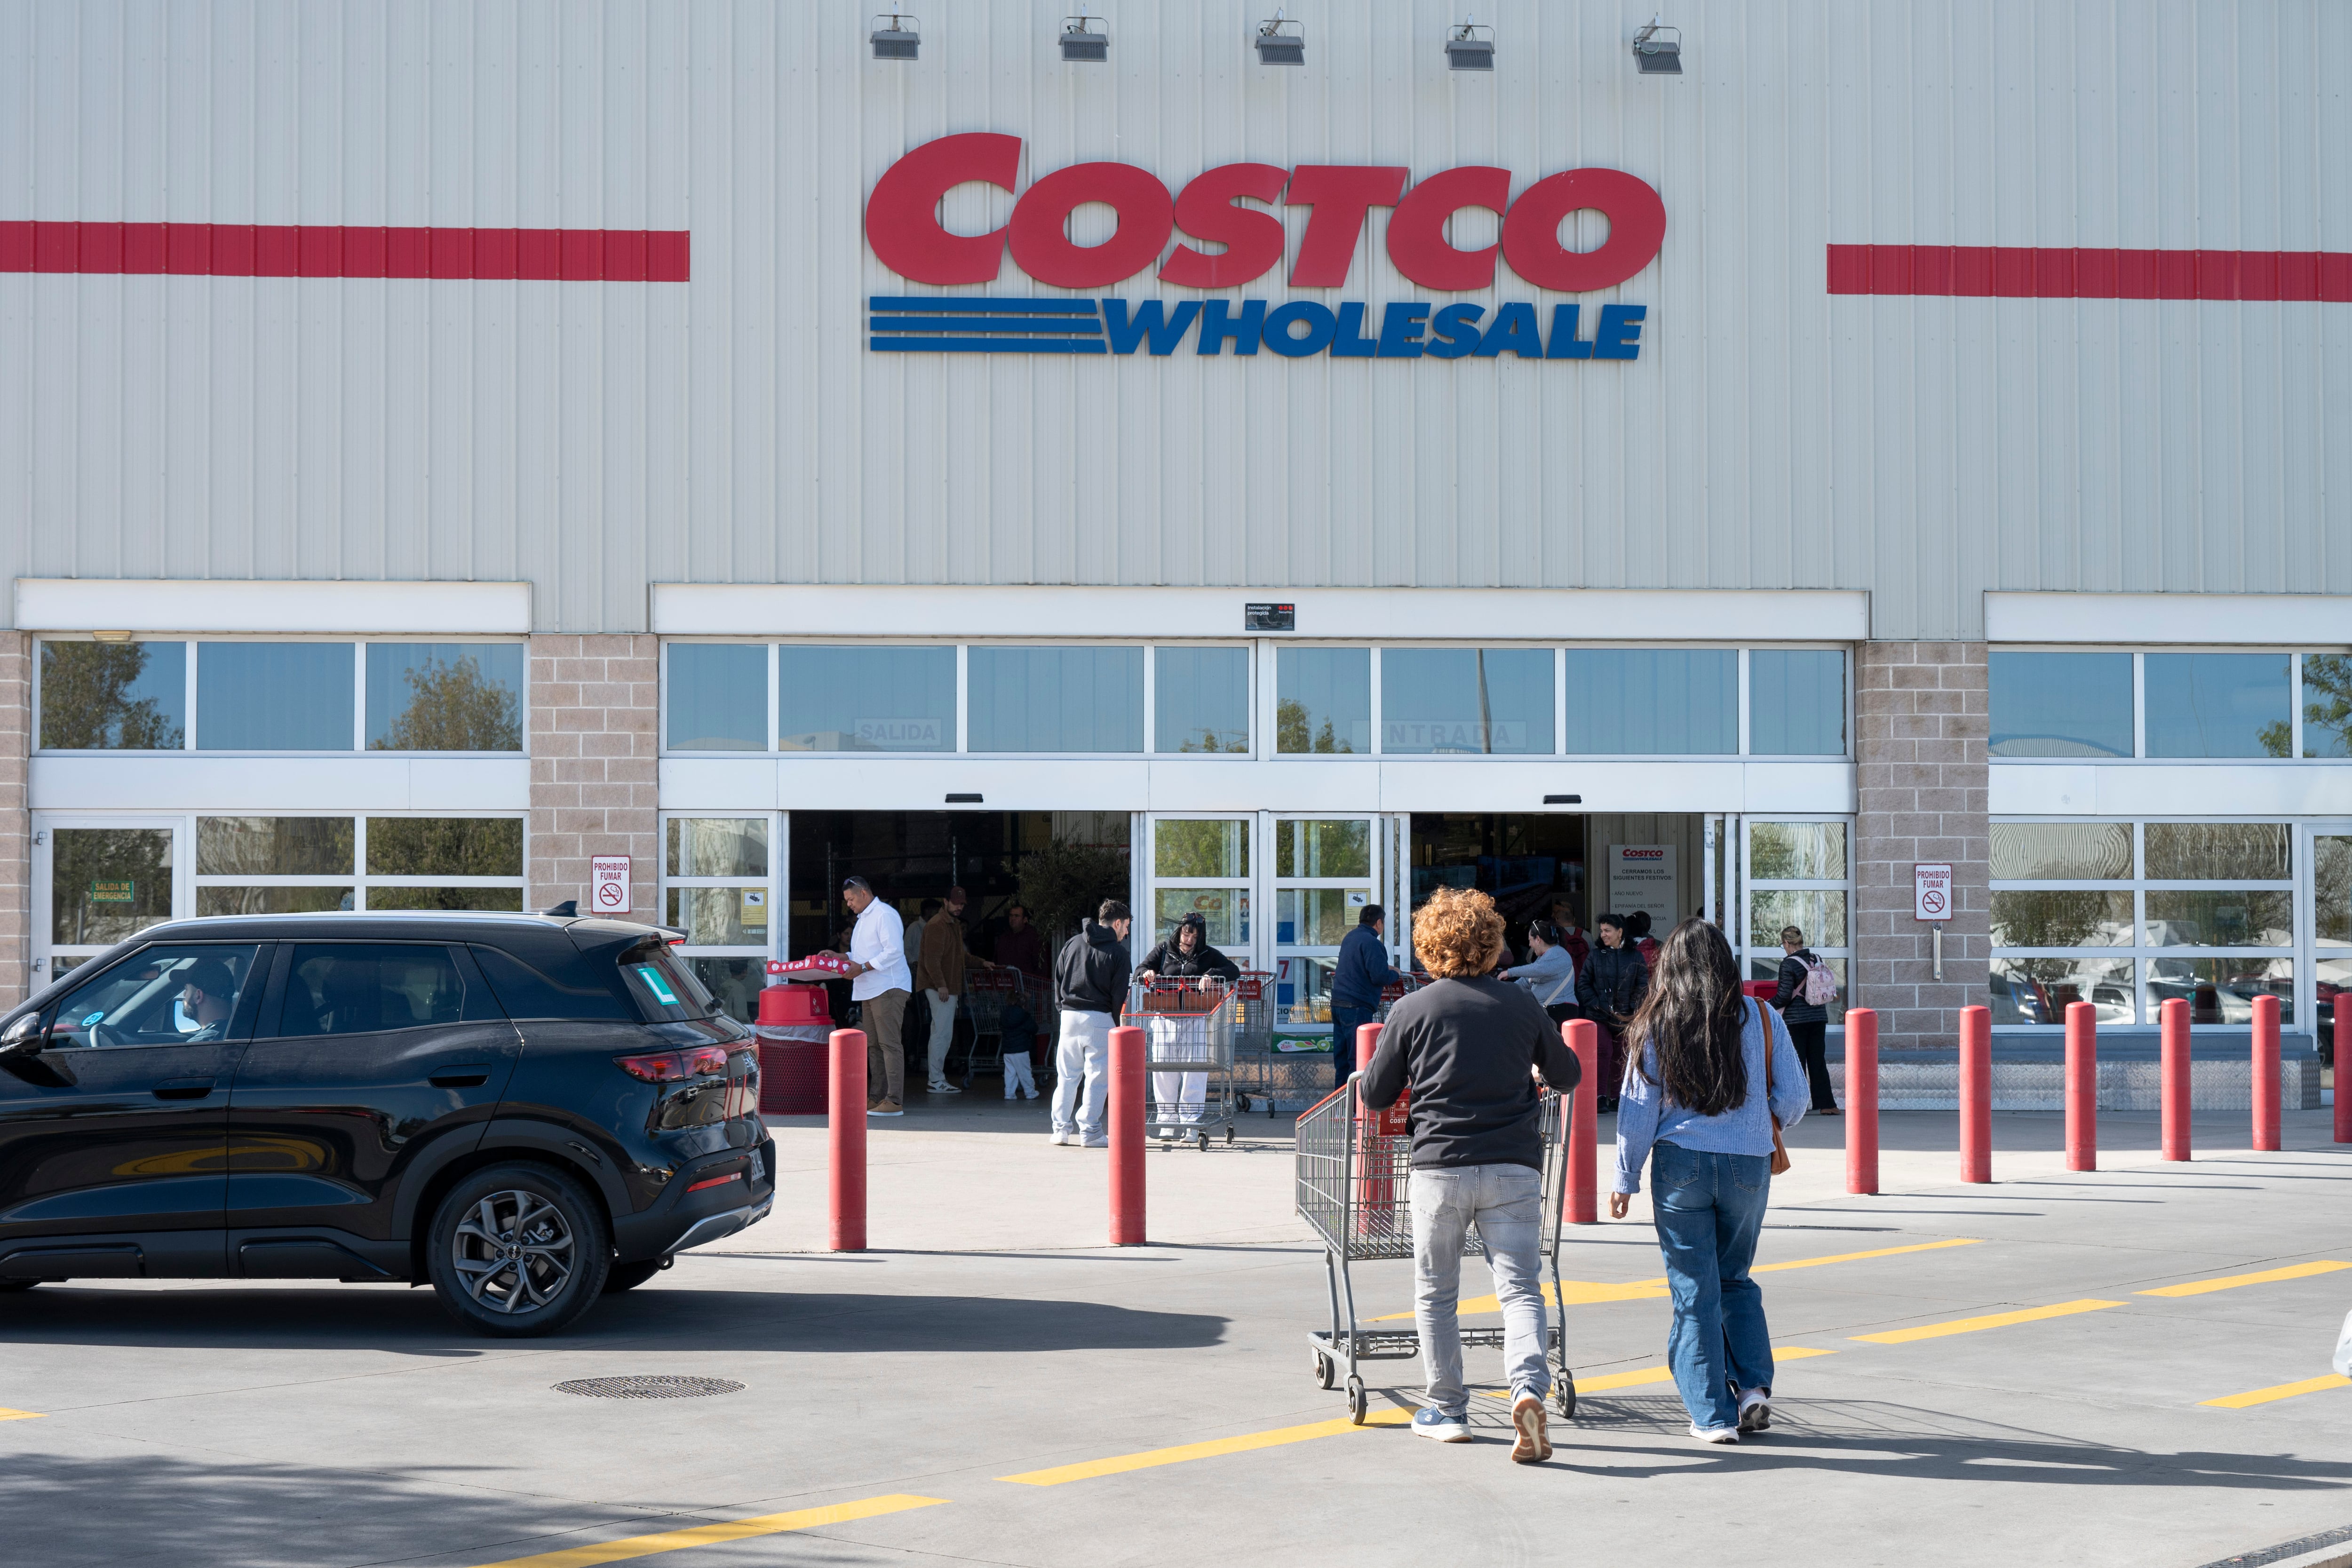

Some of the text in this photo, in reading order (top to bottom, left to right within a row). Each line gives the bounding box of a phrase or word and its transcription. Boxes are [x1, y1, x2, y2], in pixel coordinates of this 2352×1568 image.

[866, 132, 1666, 293] COSTCO
[1102, 298, 1647, 360] WHOLESALE
[860, 724, 936, 740] SALIDA
[1381, 724, 1510, 744] NTRADA
[642, 972, 676, 1002] L
